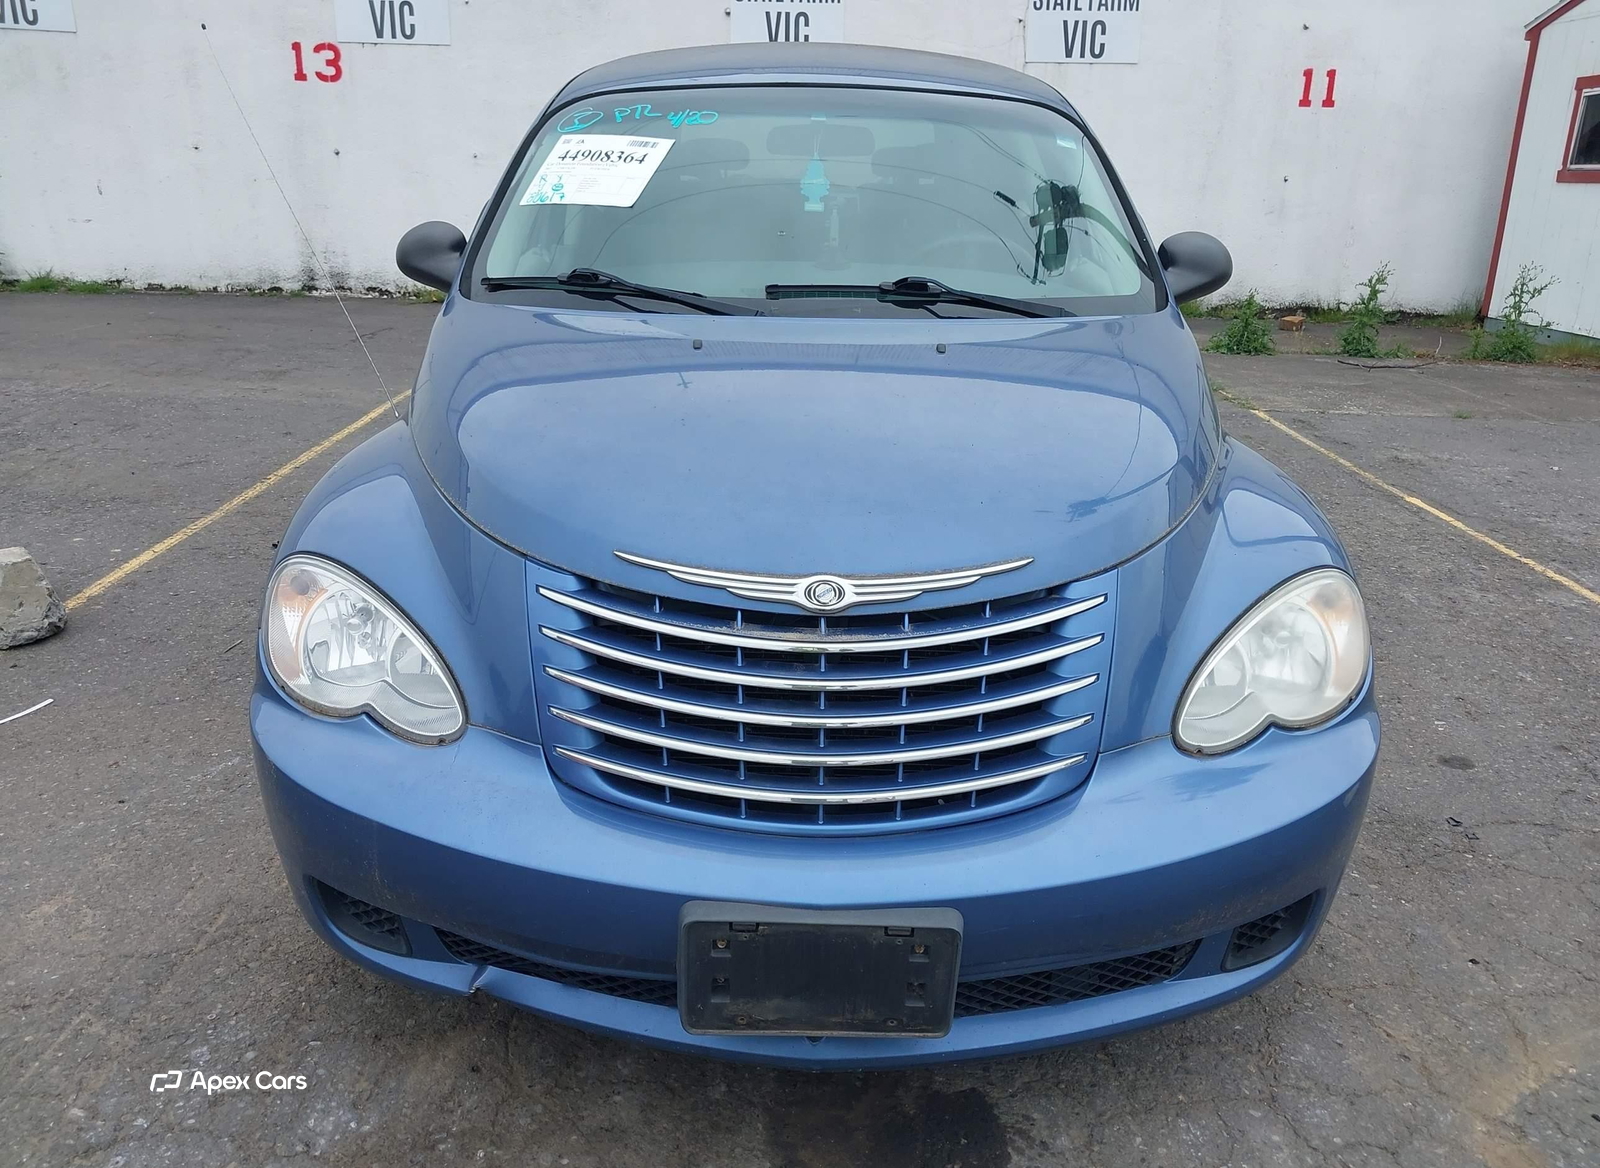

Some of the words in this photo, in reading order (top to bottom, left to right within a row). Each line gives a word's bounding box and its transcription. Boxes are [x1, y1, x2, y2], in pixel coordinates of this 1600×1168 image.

[367, 0, 416, 40] VIC
[765, 11, 810, 43] VIC
[1062, 19, 1107, 59] VIC
[291, 41, 343, 83] 13
[1298, 68, 1337, 108] 11
[557, 149, 649, 165] 44908364
